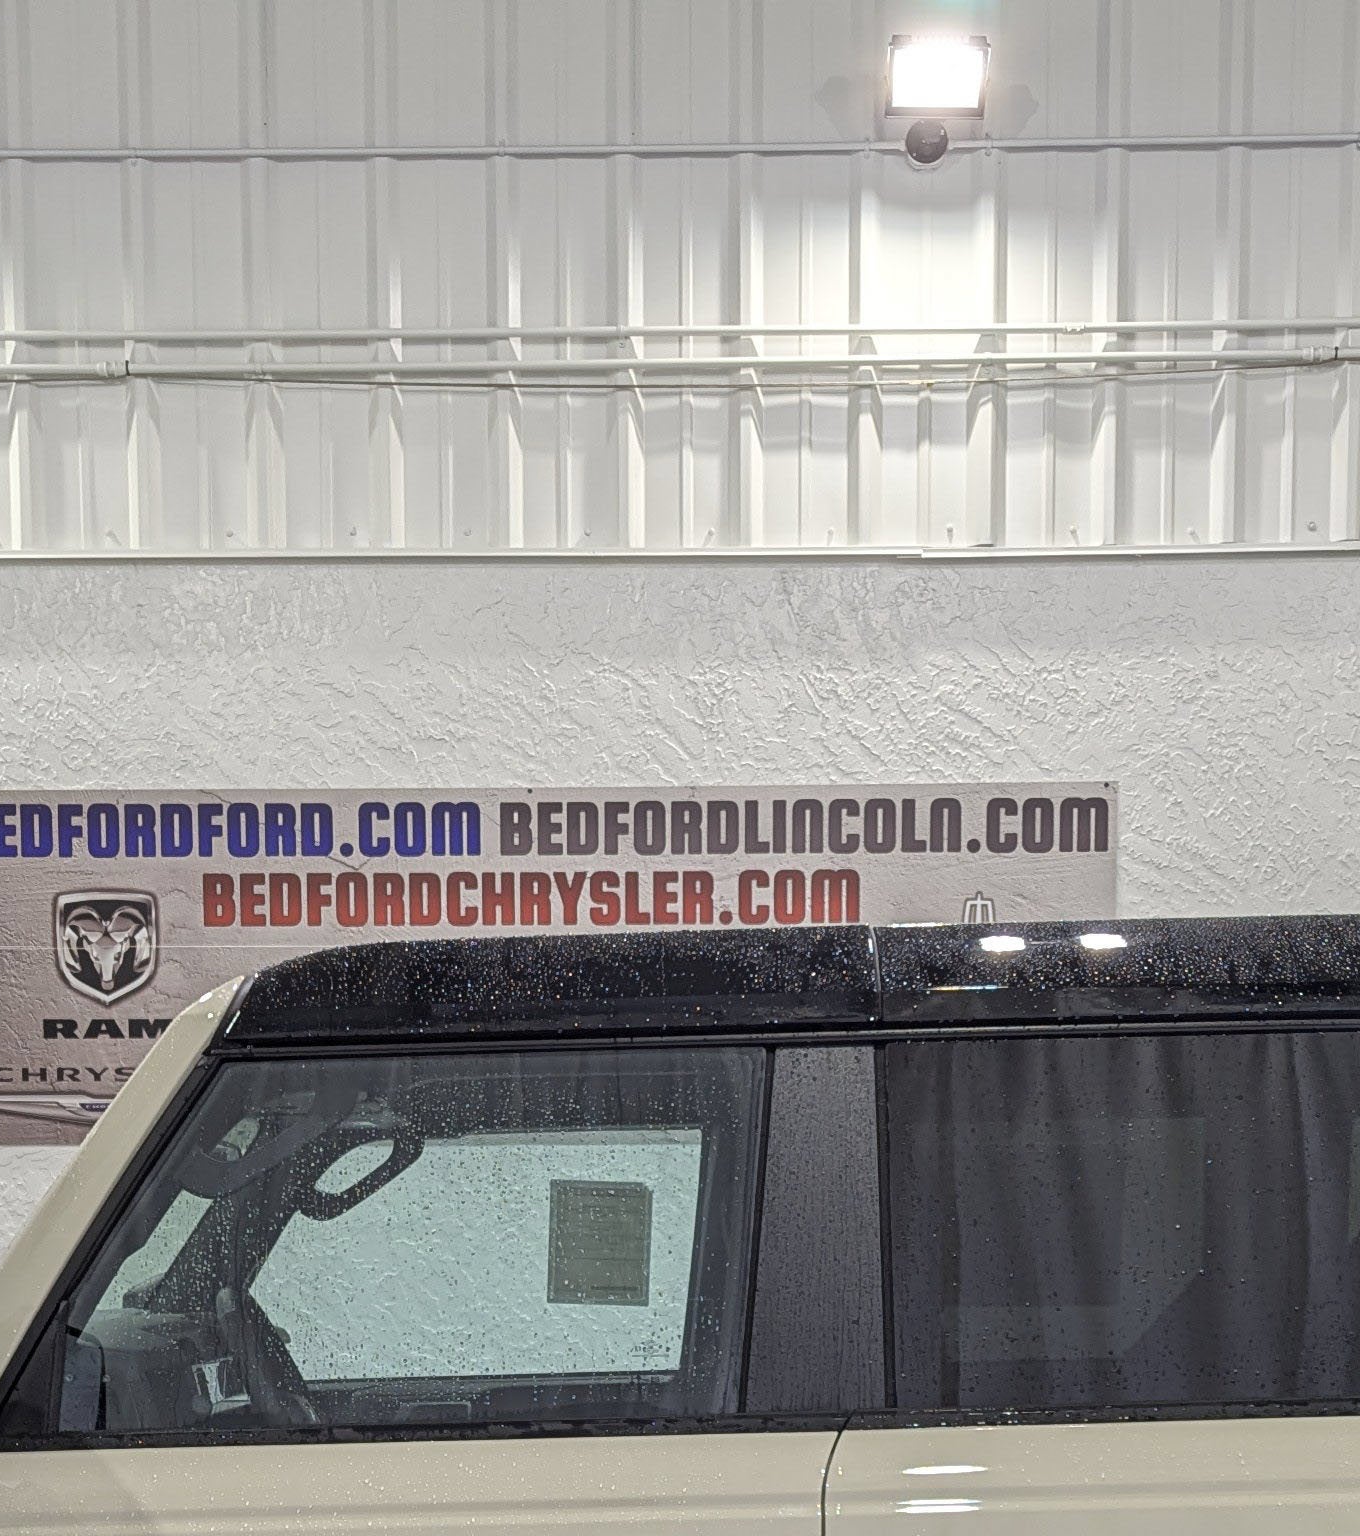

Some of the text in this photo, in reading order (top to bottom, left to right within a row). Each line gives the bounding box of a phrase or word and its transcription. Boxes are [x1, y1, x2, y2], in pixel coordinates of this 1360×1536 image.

[498, 796, 1109, 856] BEDFORDLINCOLN.COM
[202, 867, 861, 929] BEDFORDCHRYSLER.COM
[42, 1018, 173, 1040] RAM
